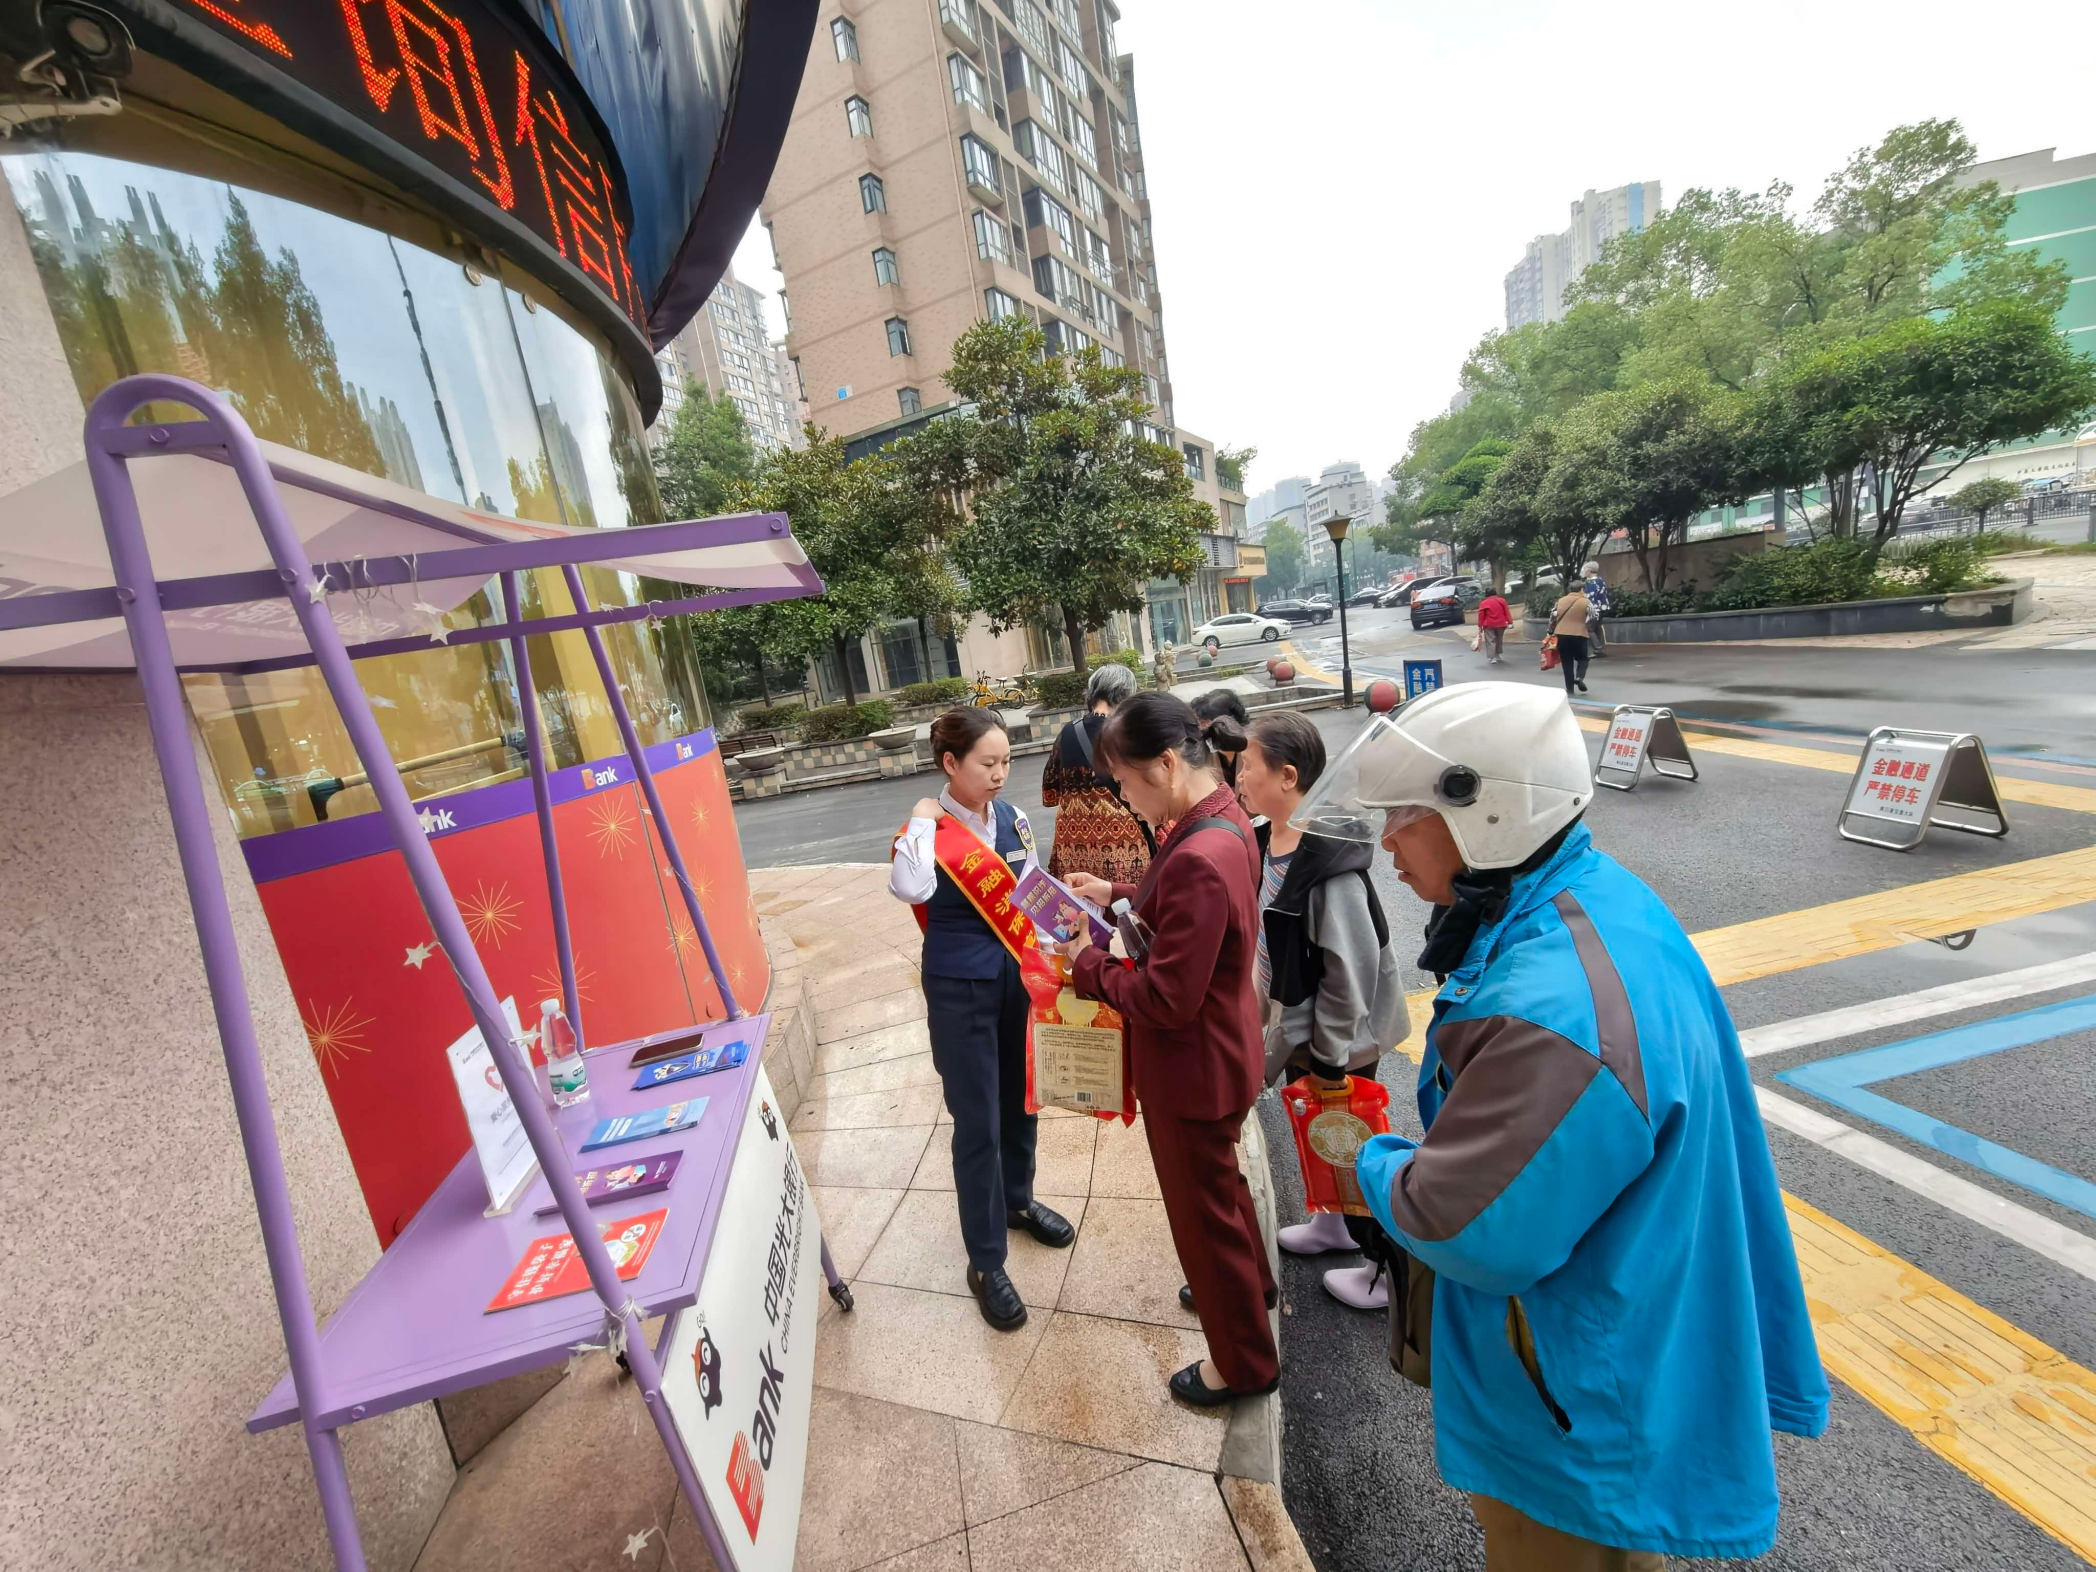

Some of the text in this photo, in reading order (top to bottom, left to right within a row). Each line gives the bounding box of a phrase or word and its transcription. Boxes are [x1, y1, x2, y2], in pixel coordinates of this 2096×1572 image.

[1412, 668, 1423, 697] 金融
[1612, 726, 1644, 742] 金融通道
[675, 743, 694, 761] Bank
[1609, 742, 1638, 759] 严禁停车
[581, 766, 618, 791] Bank
[1871, 757, 1932, 782] 金融通道
[1863, 780, 1922, 806] 严禁停车
[764, 1141, 799, 1327] 中国光大银行
[780, 1296, 793, 1354] CHINA
[788, 1206, 804, 1297] EVERBRIGHT
[725, 1339, 785, 1546] Bank
